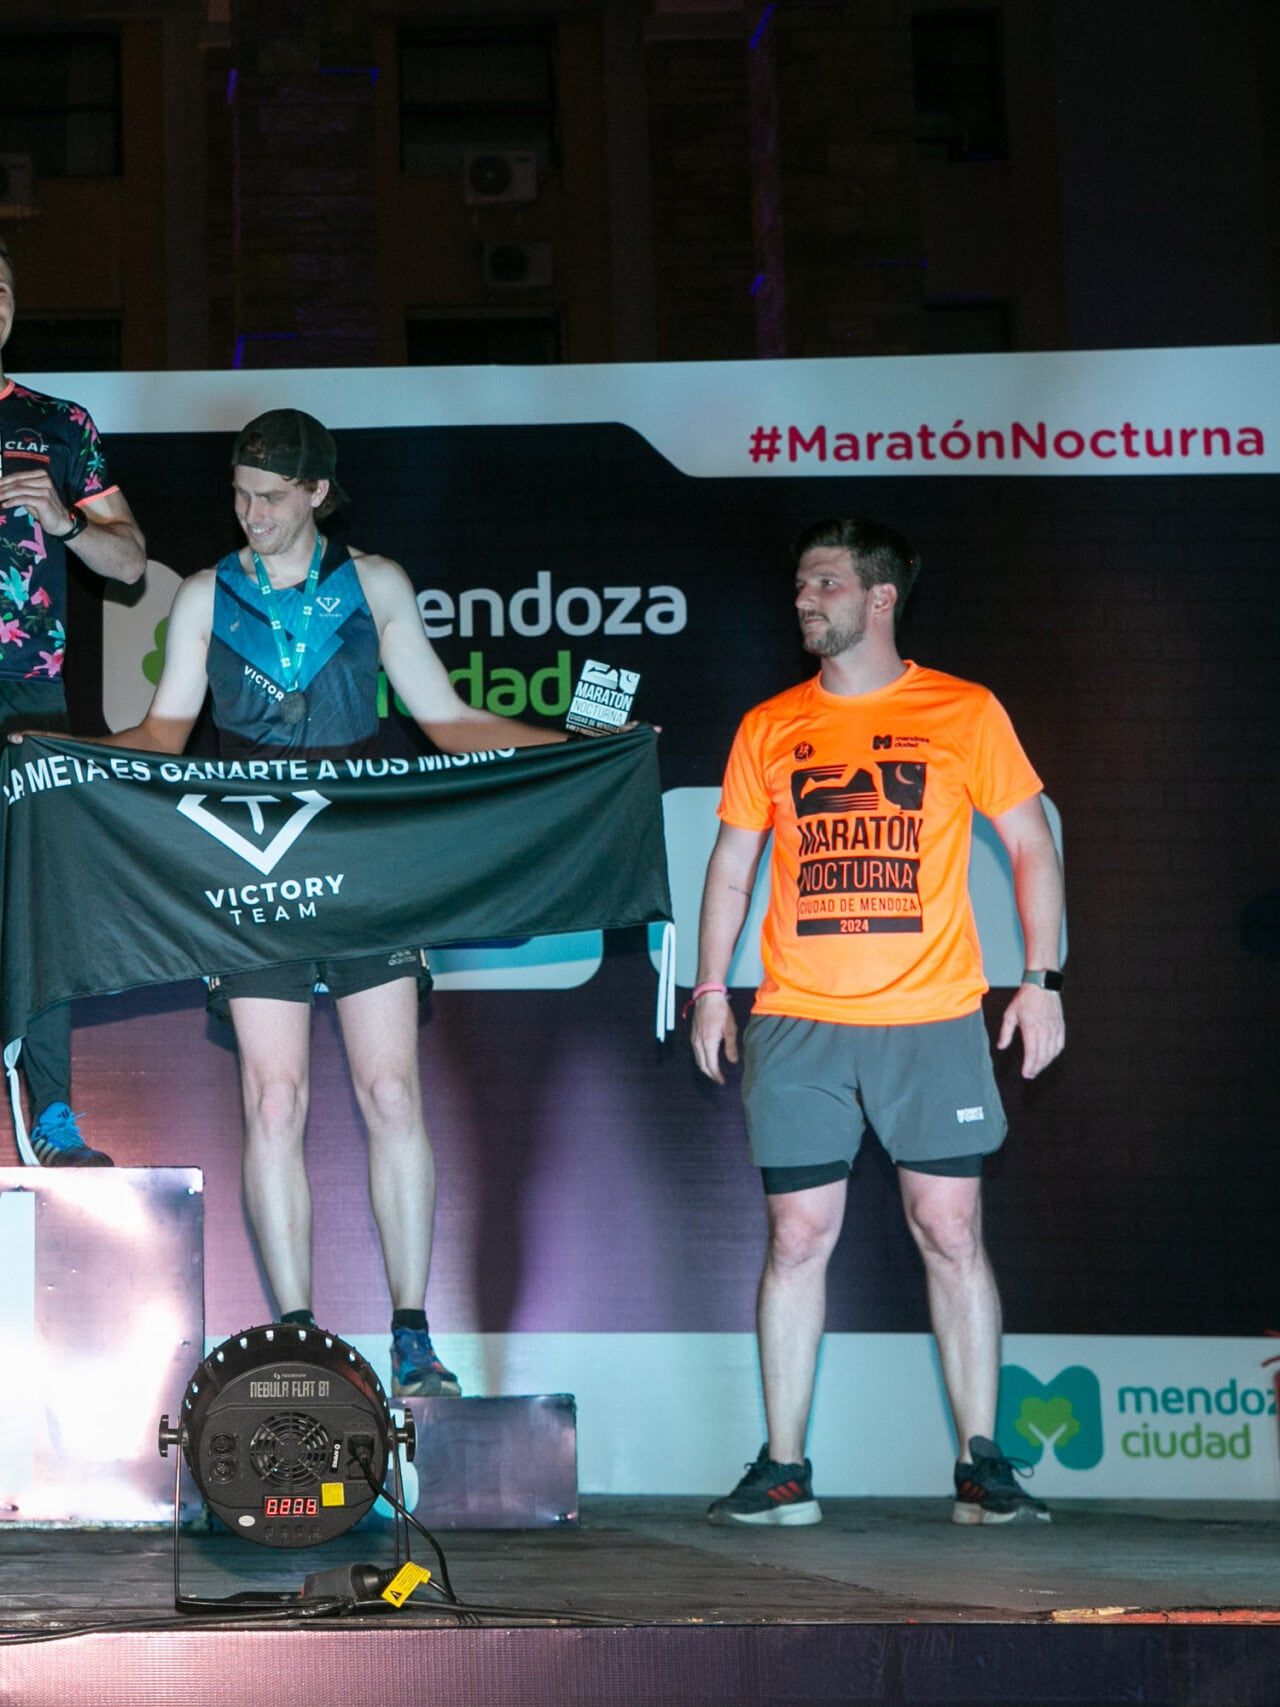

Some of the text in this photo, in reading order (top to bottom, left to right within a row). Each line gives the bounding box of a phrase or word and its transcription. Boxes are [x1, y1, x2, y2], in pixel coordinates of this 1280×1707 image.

[5, 441, 49, 453] CLAF
[748, 419, 1266, 463] #MaratónNocturna
[416, 571, 687, 639] endoza
[244, 665, 285, 702] VICTOR
[24, 755, 109, 793] META
[110, 758, 151, 781] ES
[160, 759, 309, 782] GANARTE
[317, 759, 338, 779] A
[345, 757, 409, 778] VOS
[797, 812, 923, 857] MARATÓN
[204, 873, 345, 909] VICTORY
[799, 860, 913, 892] NOCTURNA
[229, 902, 318, 927] TEAM
[840, 898, 854, 912] DE
[860, 898, 917, 912] MENDOZA
[840, 919, 869, 933] 2024
[250, 1381, 289, 1398] NEBULA
[292, 1381, 316, 1397] FLAT
[1117, 1379, 1276, 1416] mendoz
[1121, 1422, 1252, 1460] ciudad
